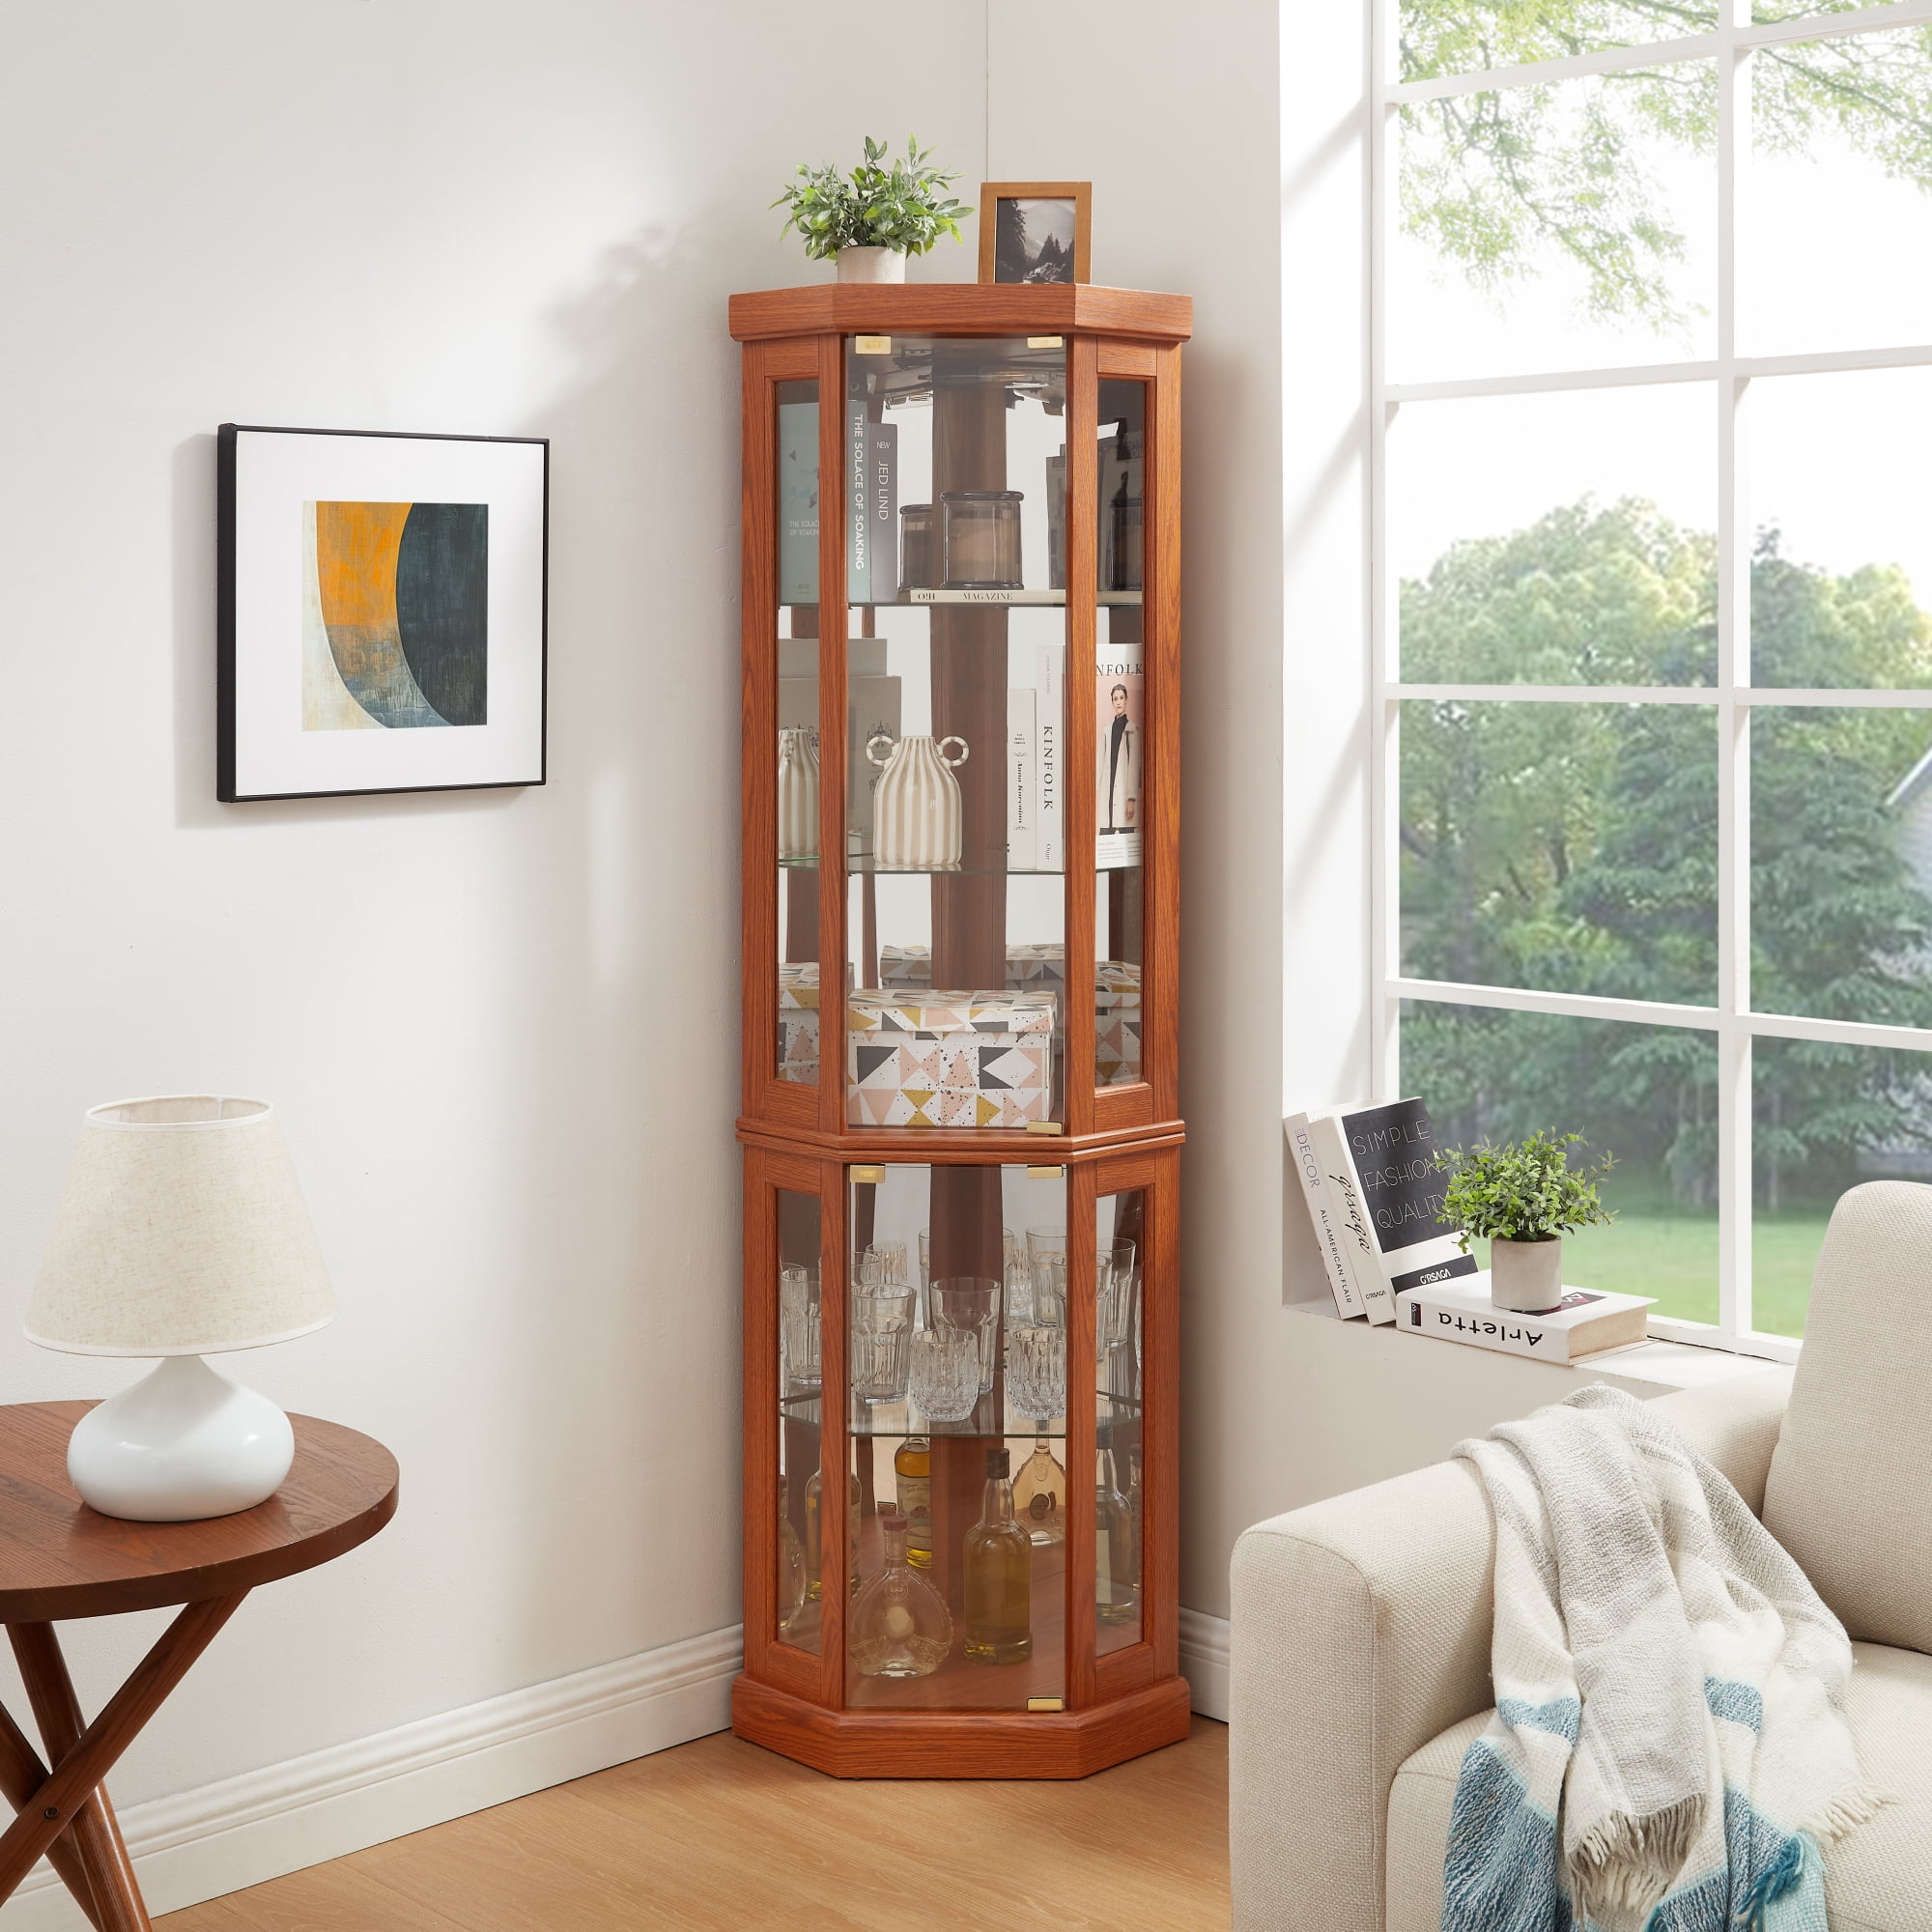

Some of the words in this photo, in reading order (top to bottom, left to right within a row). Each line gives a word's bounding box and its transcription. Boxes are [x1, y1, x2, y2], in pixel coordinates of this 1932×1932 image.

[854, 442, 864, 489] SOLACE
[878, 461, 889, 485] JED
[855, 494, 864, 510] OF
[878, 489, 889, 521] LIND
[855, 515, 865, 570] SOAKING
[1096, 664, 1143, 676] NFOLK
[1043, 725, 1053, 810] KINFOLK
[1352, 1120, 1431, 1155] SIMPLE
[1296, 1133, 1321, 1188] DECOR
[1363, 1158, 1441, 1191] FASHION
[1320, 1208, 1344, 1276] ALL-AMERICAN
[1340, 1279, 1352, 1304] FLAIR
[1437, 1312, 1543, 1347] Arletta
